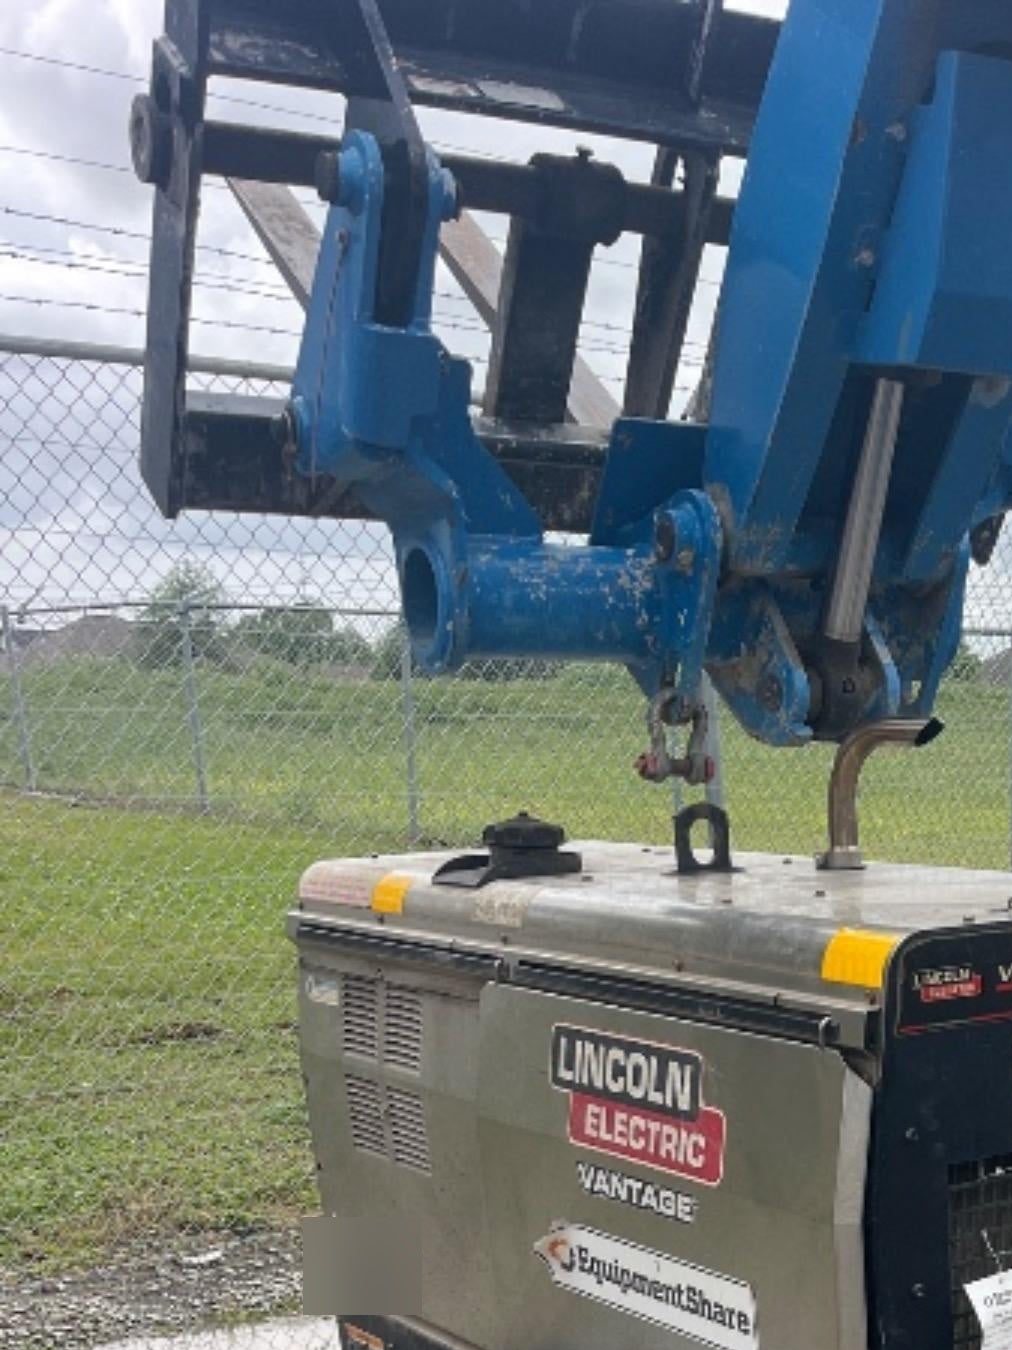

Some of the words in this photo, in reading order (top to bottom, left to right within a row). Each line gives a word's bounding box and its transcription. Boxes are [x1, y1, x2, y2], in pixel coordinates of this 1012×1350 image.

[558, 1036, 692, 1111] LINCOLN
[584, 1103, 706, 1168] ELECTRIC
[576, 1161, 697, 1224] VANTAGE
[577, 1246, 751, 1335] EquipmentShare
